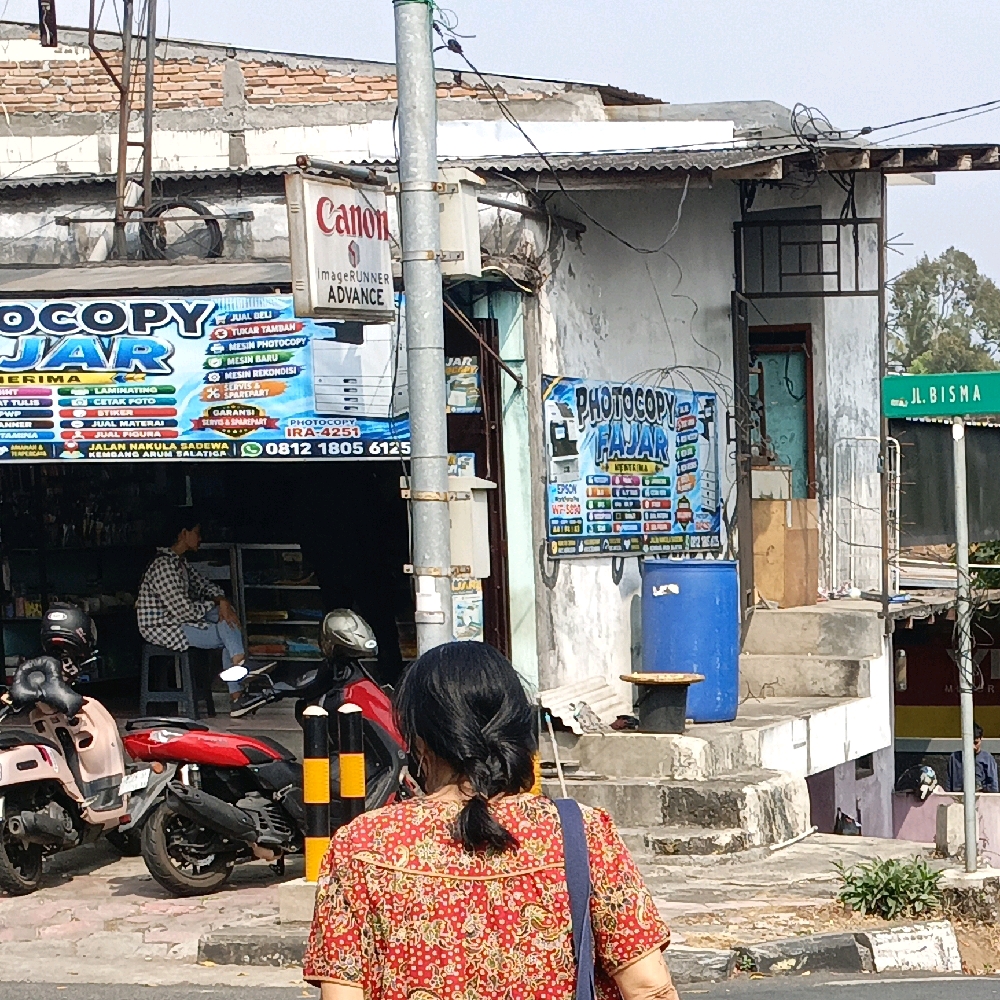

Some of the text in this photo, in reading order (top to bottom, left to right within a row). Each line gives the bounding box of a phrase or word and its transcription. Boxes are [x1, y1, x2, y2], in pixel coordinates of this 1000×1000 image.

[316, 196, 389, 241] Canon
[328, 285, 384, 305] ADVANCE
[0, 302, 210, 333] OCOPY
[230, 313, 252, 321] JUAL
[232, 323, 296, 335] TUKAR TAMBAH
[229, 337, 307, 351] MESIN PHOTOCOPY
[0, 336, 170, 370] JAR
[226, 354, 278, 365] MESIN BARU
[224, 367, 297, 379] MESIN REKONDISI
[94, 386, 158, 394] LAMINATING
[223, 389, 270, 399] SPAREPART
[911, 384, 981, 404] JL. BISMA
[575, 385, 676, 428] PHOTOCOPY
[123, 430, 162, 438] FIGURA
[287, 427, 359, 437] IRA-4251
[89, 443, 127, 451] JALAN
[180, 442, 229, 450] SADEWA
[596, 421, 669, 463] FAJAR
[265, 442, 411, 455] 0812 1805 6125
[557, 484, 578, 494] EPSON
